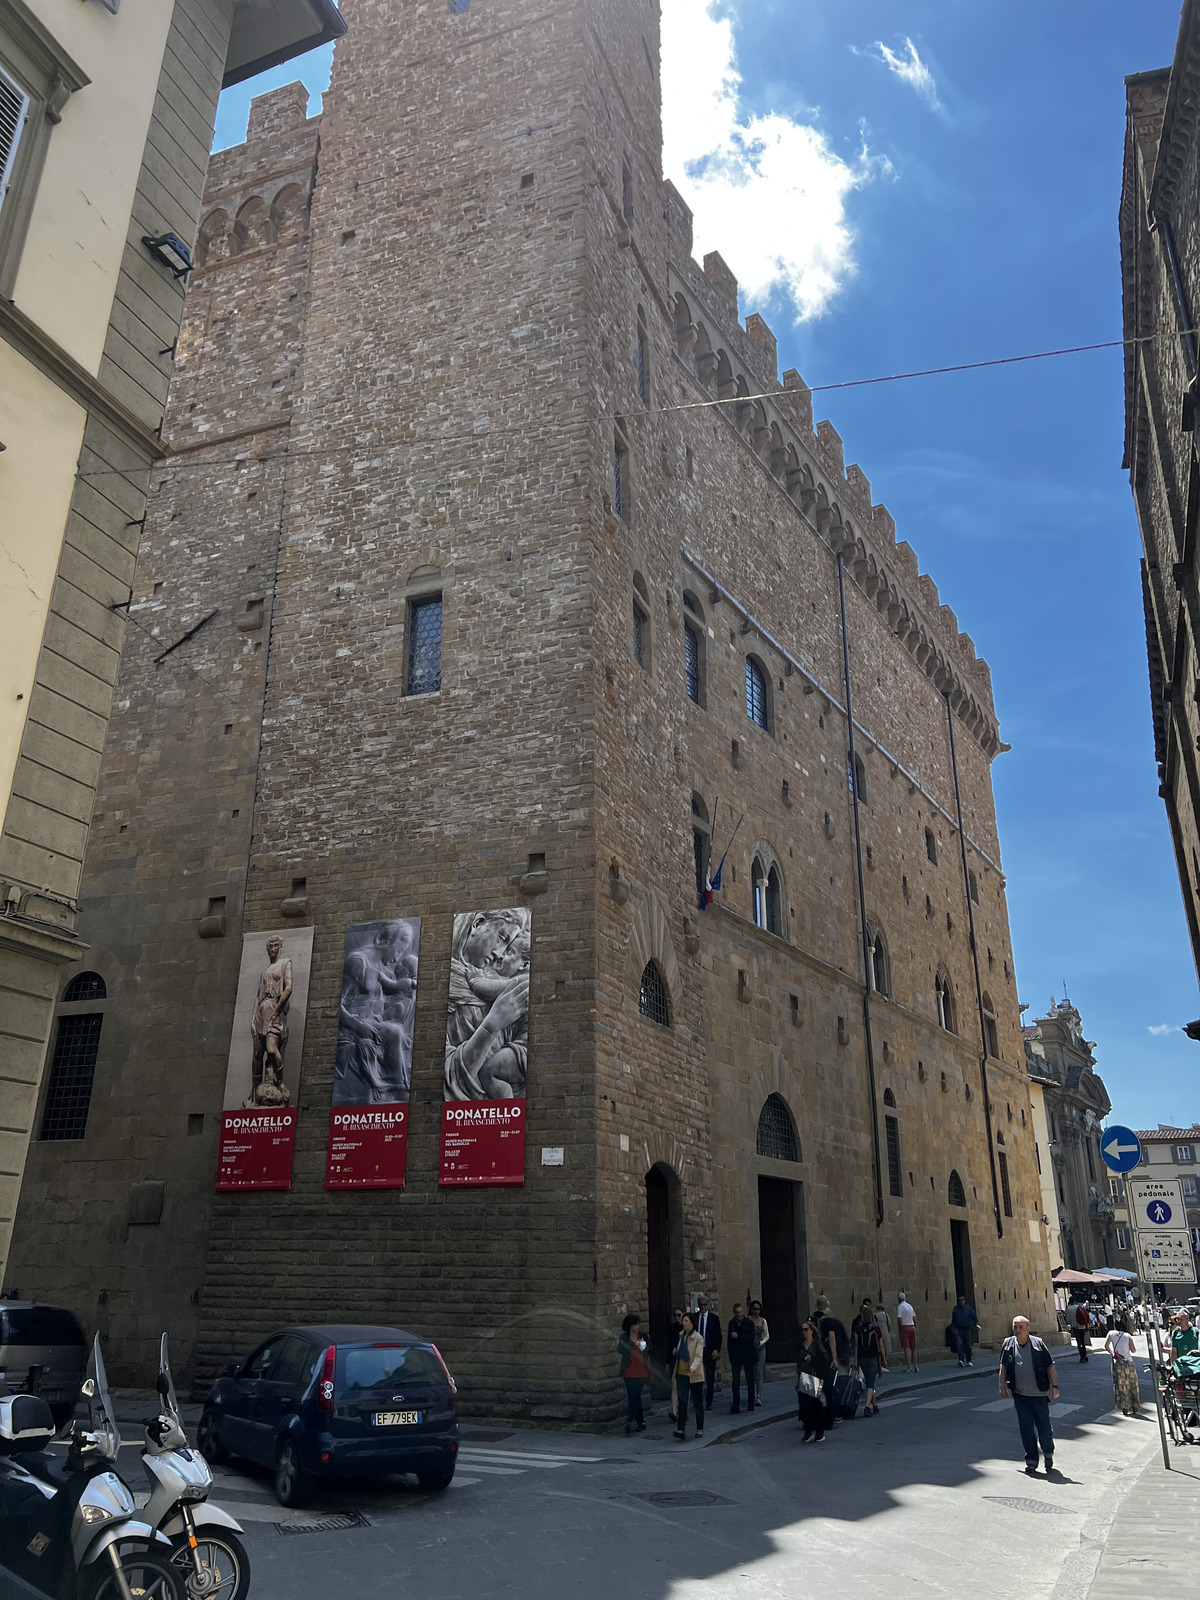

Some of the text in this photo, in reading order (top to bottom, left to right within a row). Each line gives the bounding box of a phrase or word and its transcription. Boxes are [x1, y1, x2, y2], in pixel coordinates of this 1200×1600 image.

[334, 1111, 404, 1125] DONATELLO
[446, 1106, 521, 1121] DONATELLO
[225, 1115, 292, 1129] DONATELLO
[350, 1123, 395, 1131] RINASCIMENTO
[456, 1117, 511, 1127] IL RINASCIMENTO
[240, 1126, 283, 1134] RINASCIMENTO
[1138, 1190, 1174, 1198] pedonale
[377, 1414, 388, 1425] EF
[391, 1413, 417, 1424] 779EK
